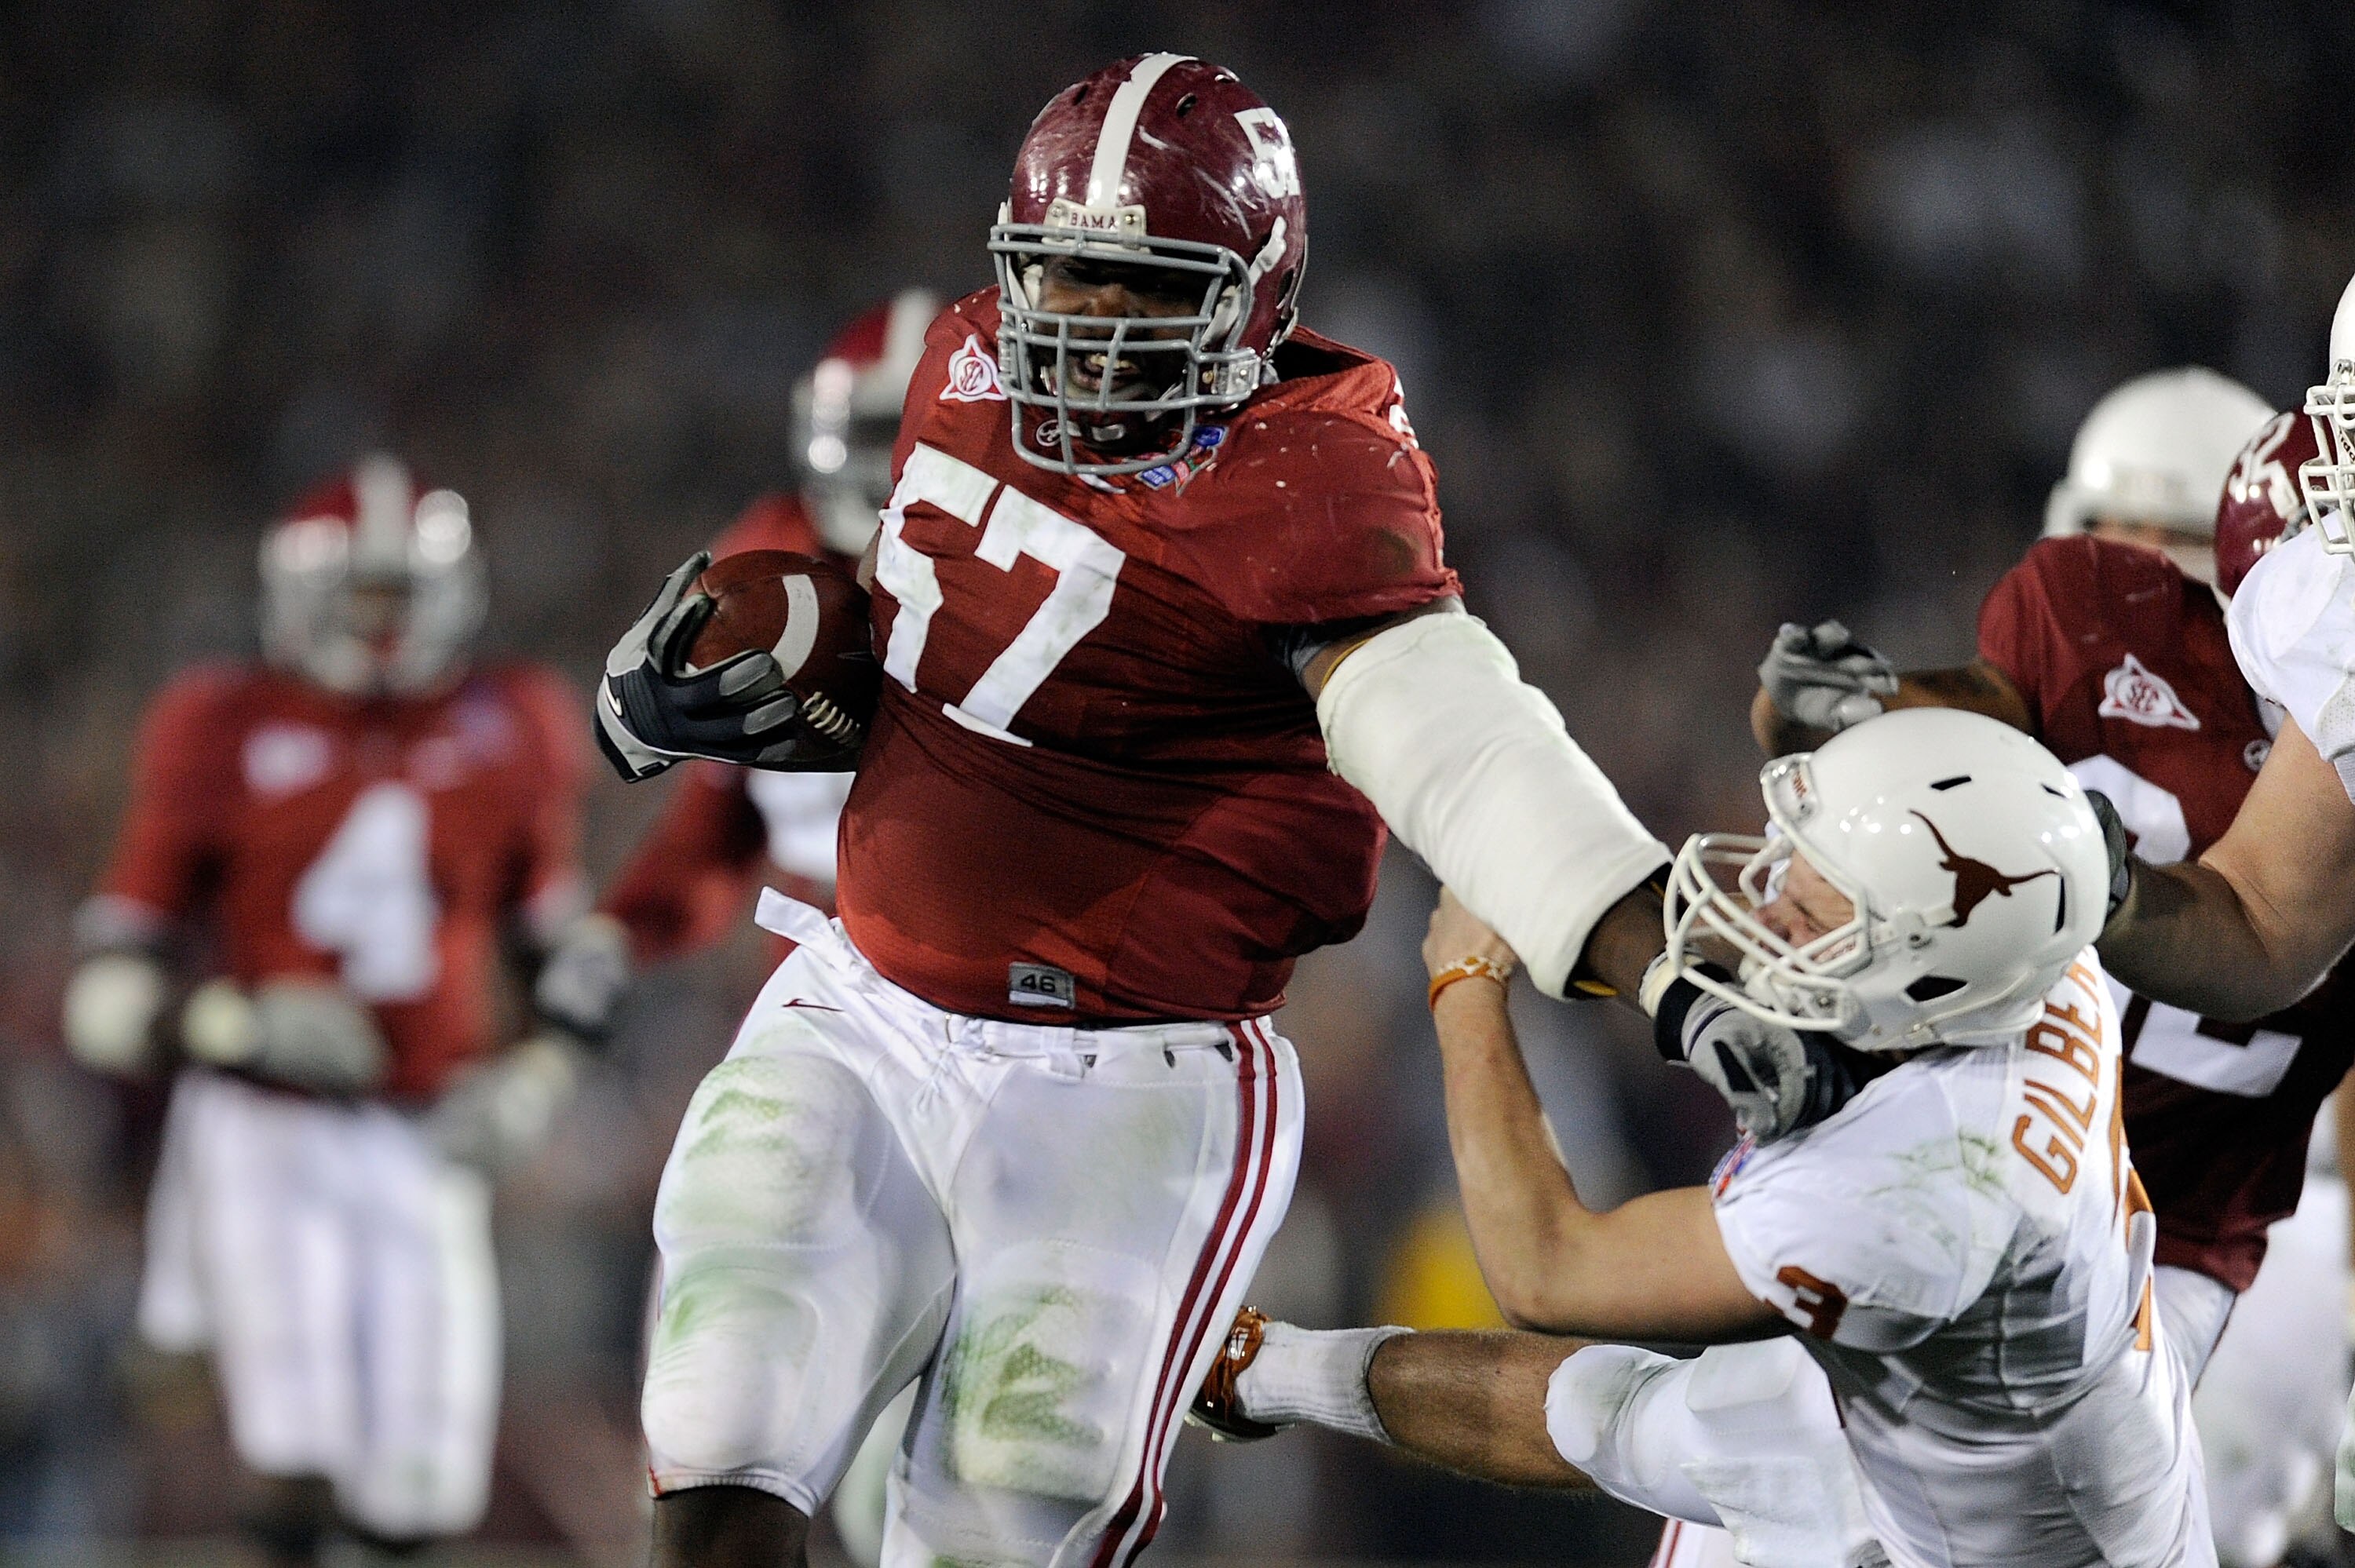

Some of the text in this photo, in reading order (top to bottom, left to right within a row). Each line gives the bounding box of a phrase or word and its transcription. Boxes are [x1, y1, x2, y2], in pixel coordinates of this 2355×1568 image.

[1069, 212, 1118, 229] BAMA
[875, 441, 1126, 747] 57
[292, 785, 444, 1001] 4
[1020, 974, 1056, 993] 46
[1777, 1265, 1848, 1341] 3
